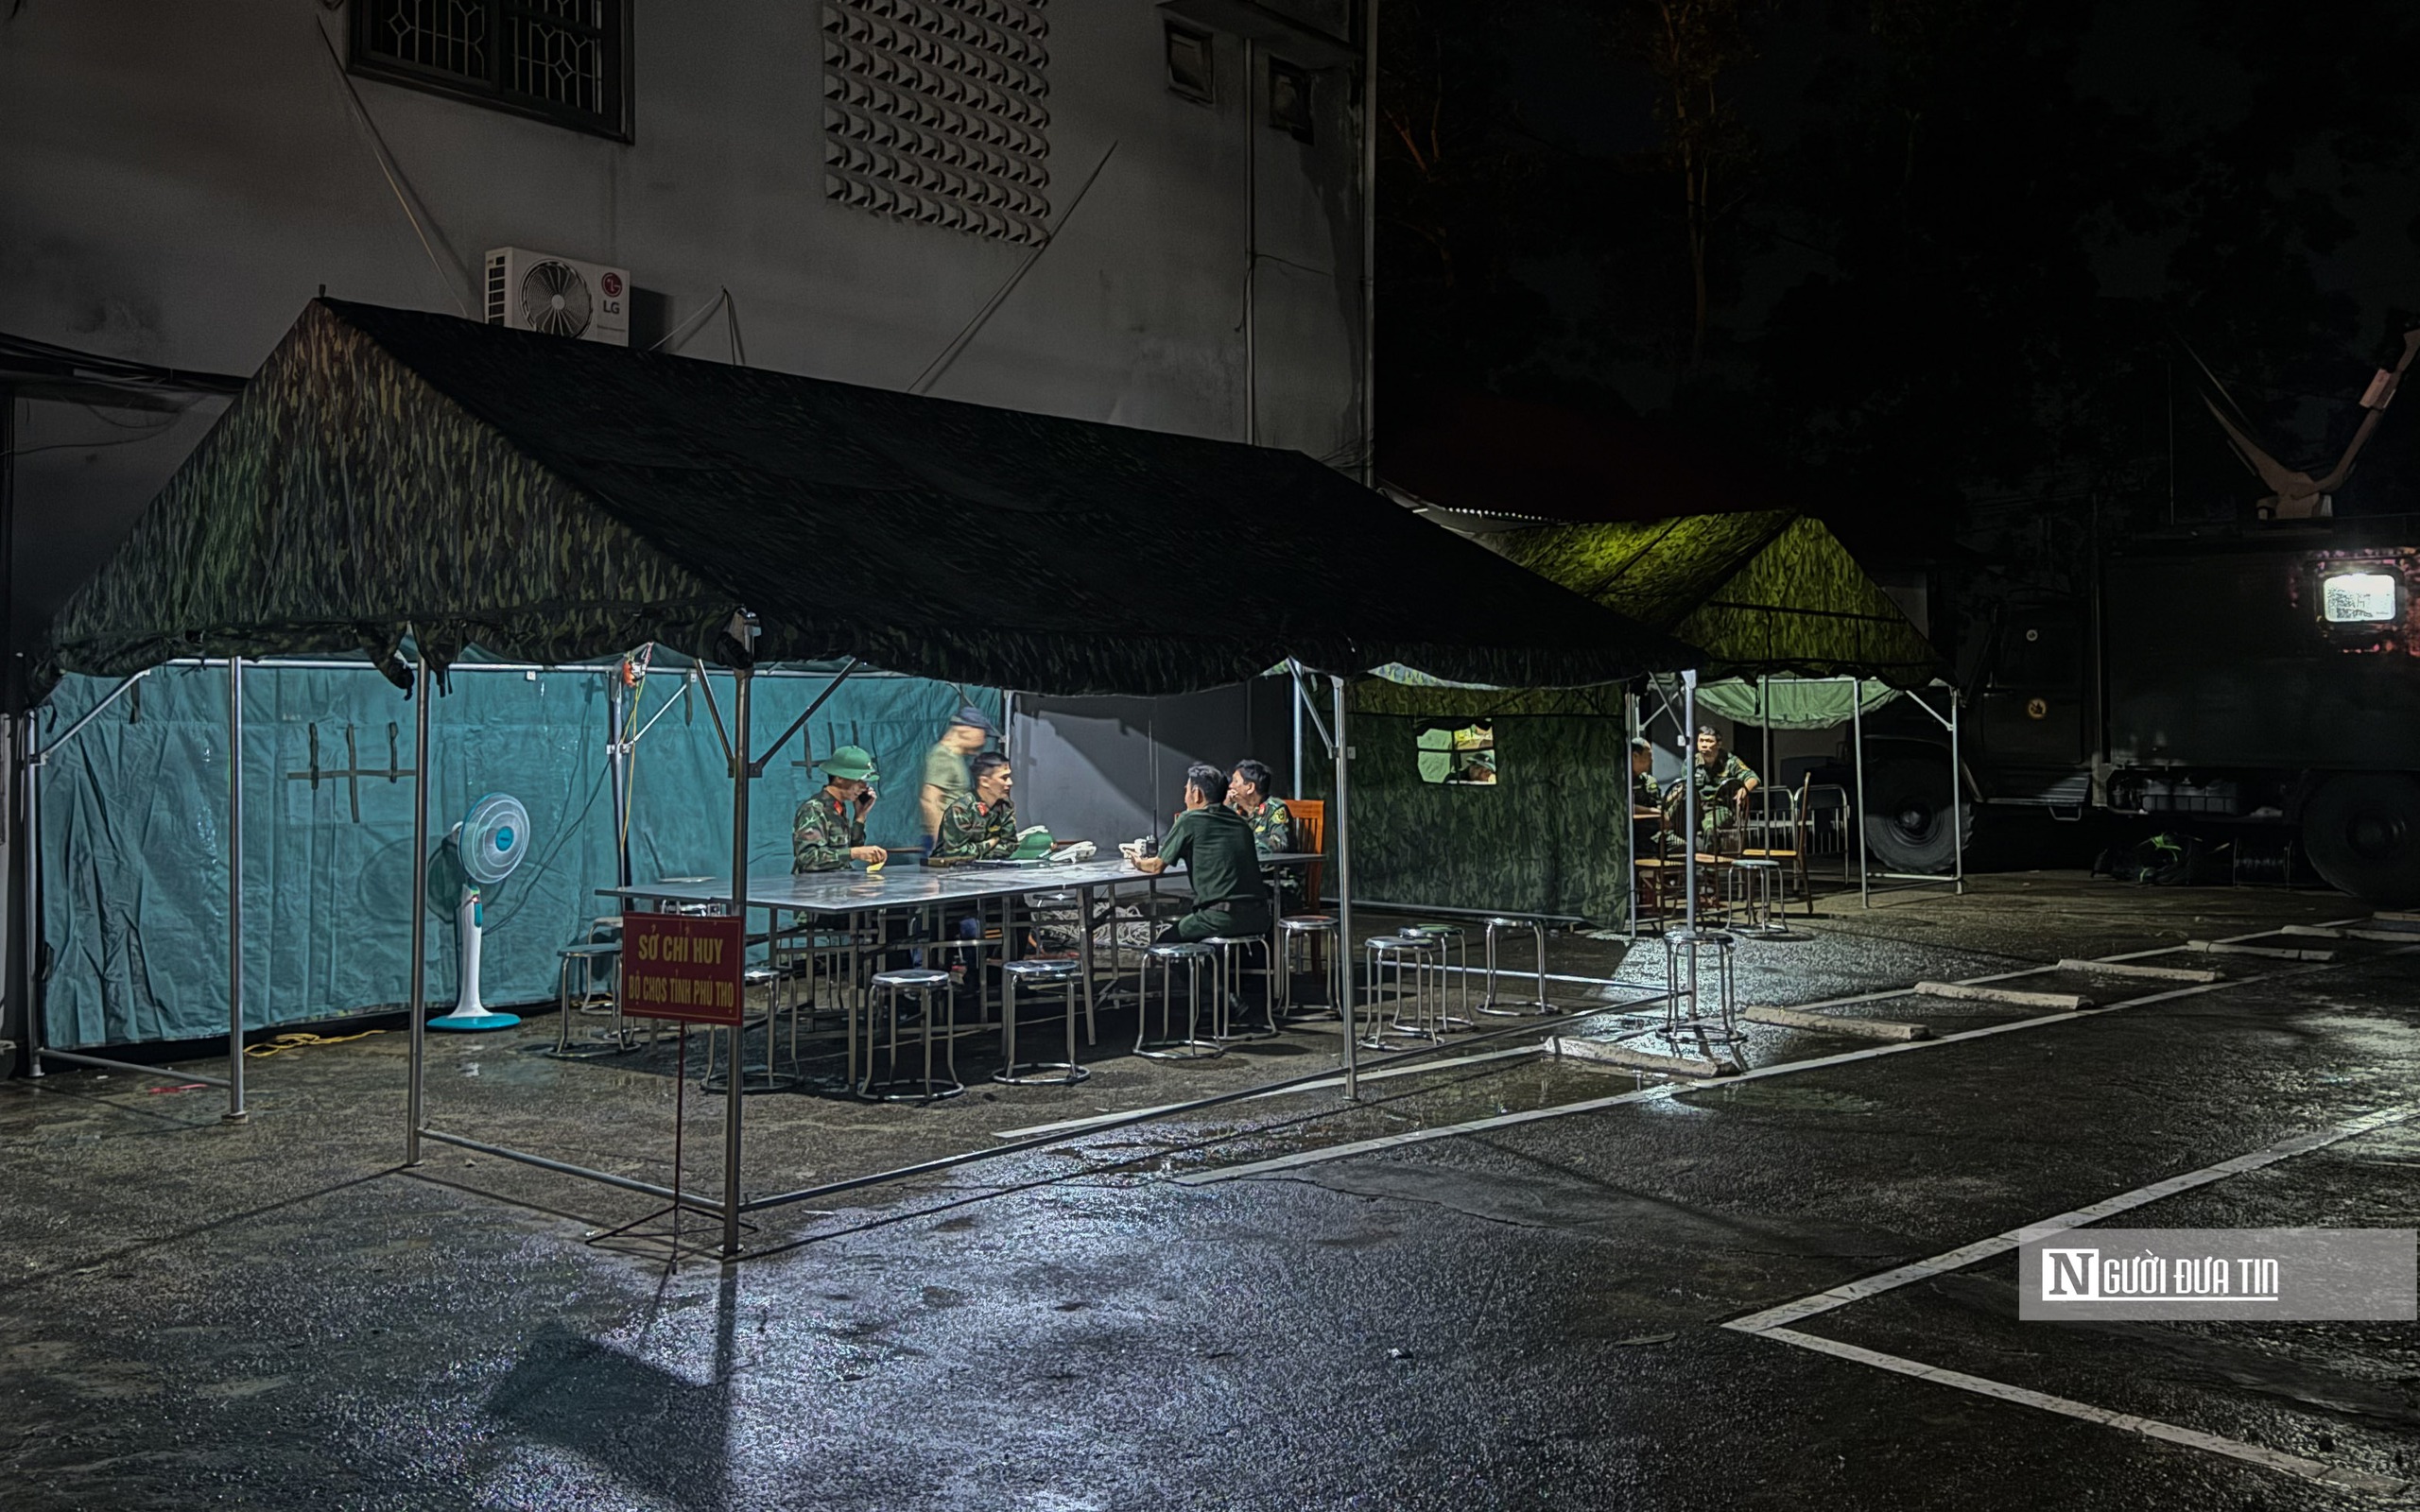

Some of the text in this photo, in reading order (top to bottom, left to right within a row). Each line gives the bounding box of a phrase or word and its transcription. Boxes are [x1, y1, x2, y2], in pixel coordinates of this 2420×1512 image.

[603, 300, 620, 315] LG
[638, 923, 724, 965] SỞ CHỈ HUY
[643, 975, 667, 1005] CHQS
[693, 974, 714, 1006] PHÚ
[716, 980, 735, 1014] THỌ
